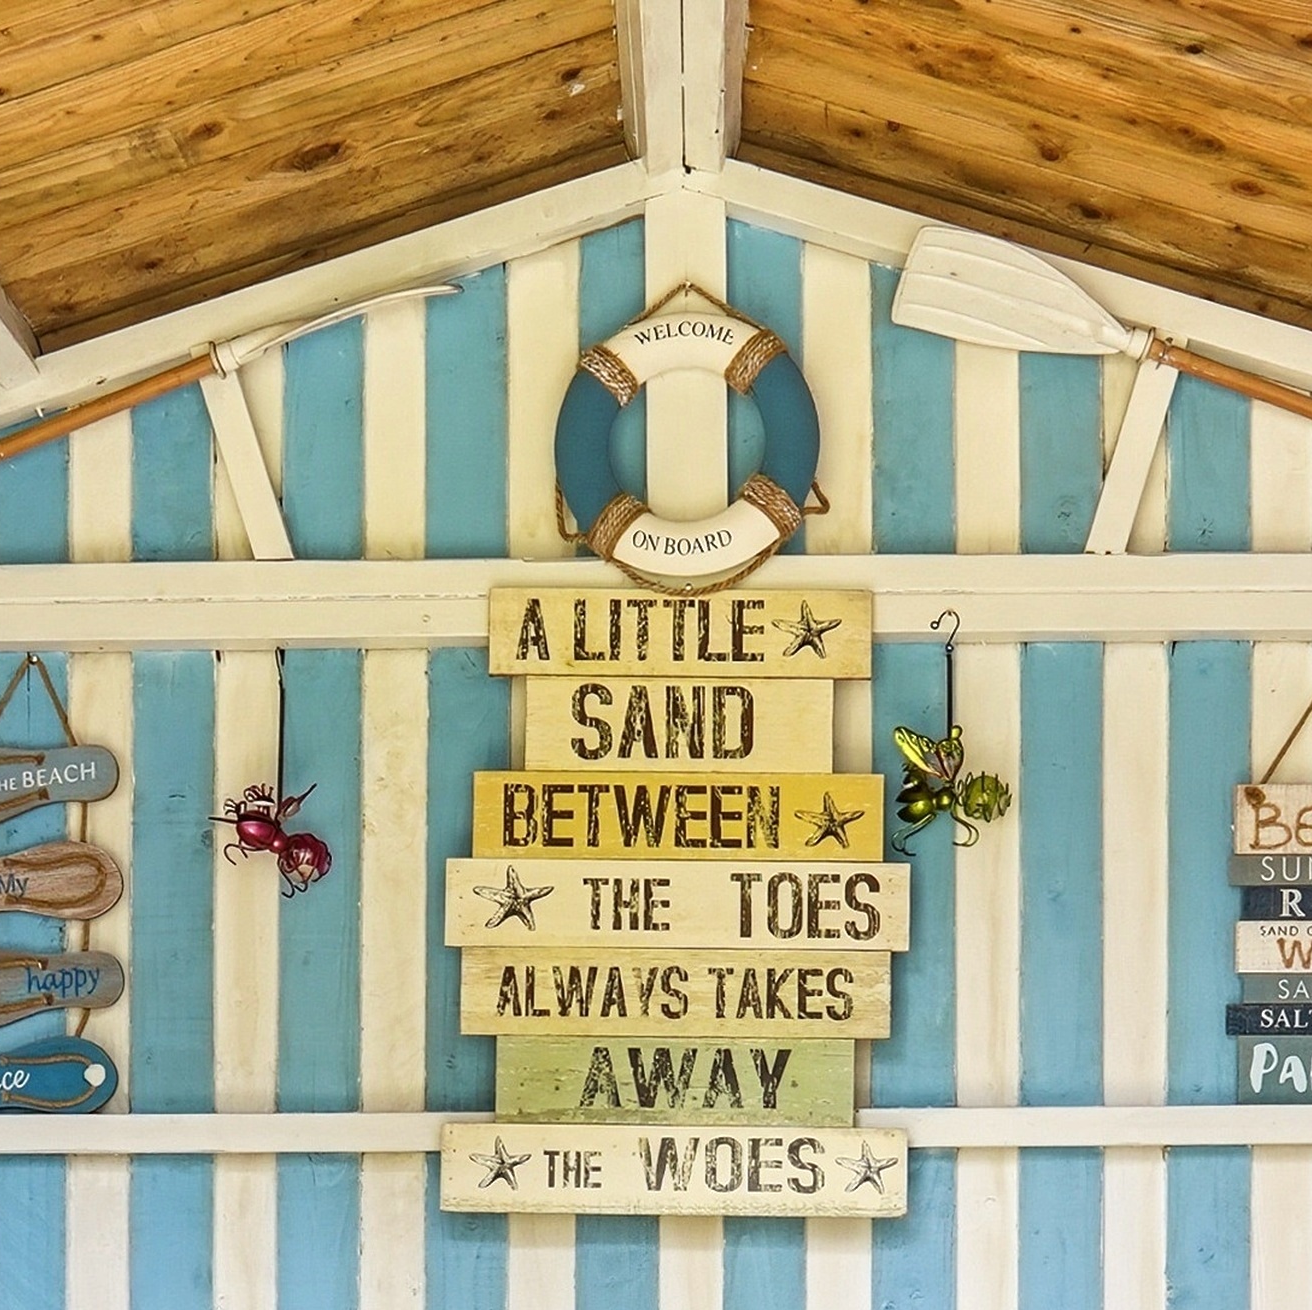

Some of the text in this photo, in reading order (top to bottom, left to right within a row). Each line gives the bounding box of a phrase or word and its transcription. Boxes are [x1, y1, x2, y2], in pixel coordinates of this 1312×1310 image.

[634, 320, 734, 346] WELCOME
[632, 529, 732, 556] ON BOARD
[515, 598, 765, 662] A LITTLE
[570, 683, 754, 760] SAND
[22, 761, 96, 788] BEACH
[503, 783, 780, 849] BETWEEN
[583, 872, 880, 941] THE TOES
[1260, 925, 1299, 936] SAND
[26, 965, 101, 998] happy
[496, 965, 854, 1021] ALWAYS TAKES
[579, 1047, 792, 1110] AWAY
[543, 1137, 826, 1194] THE WOES
